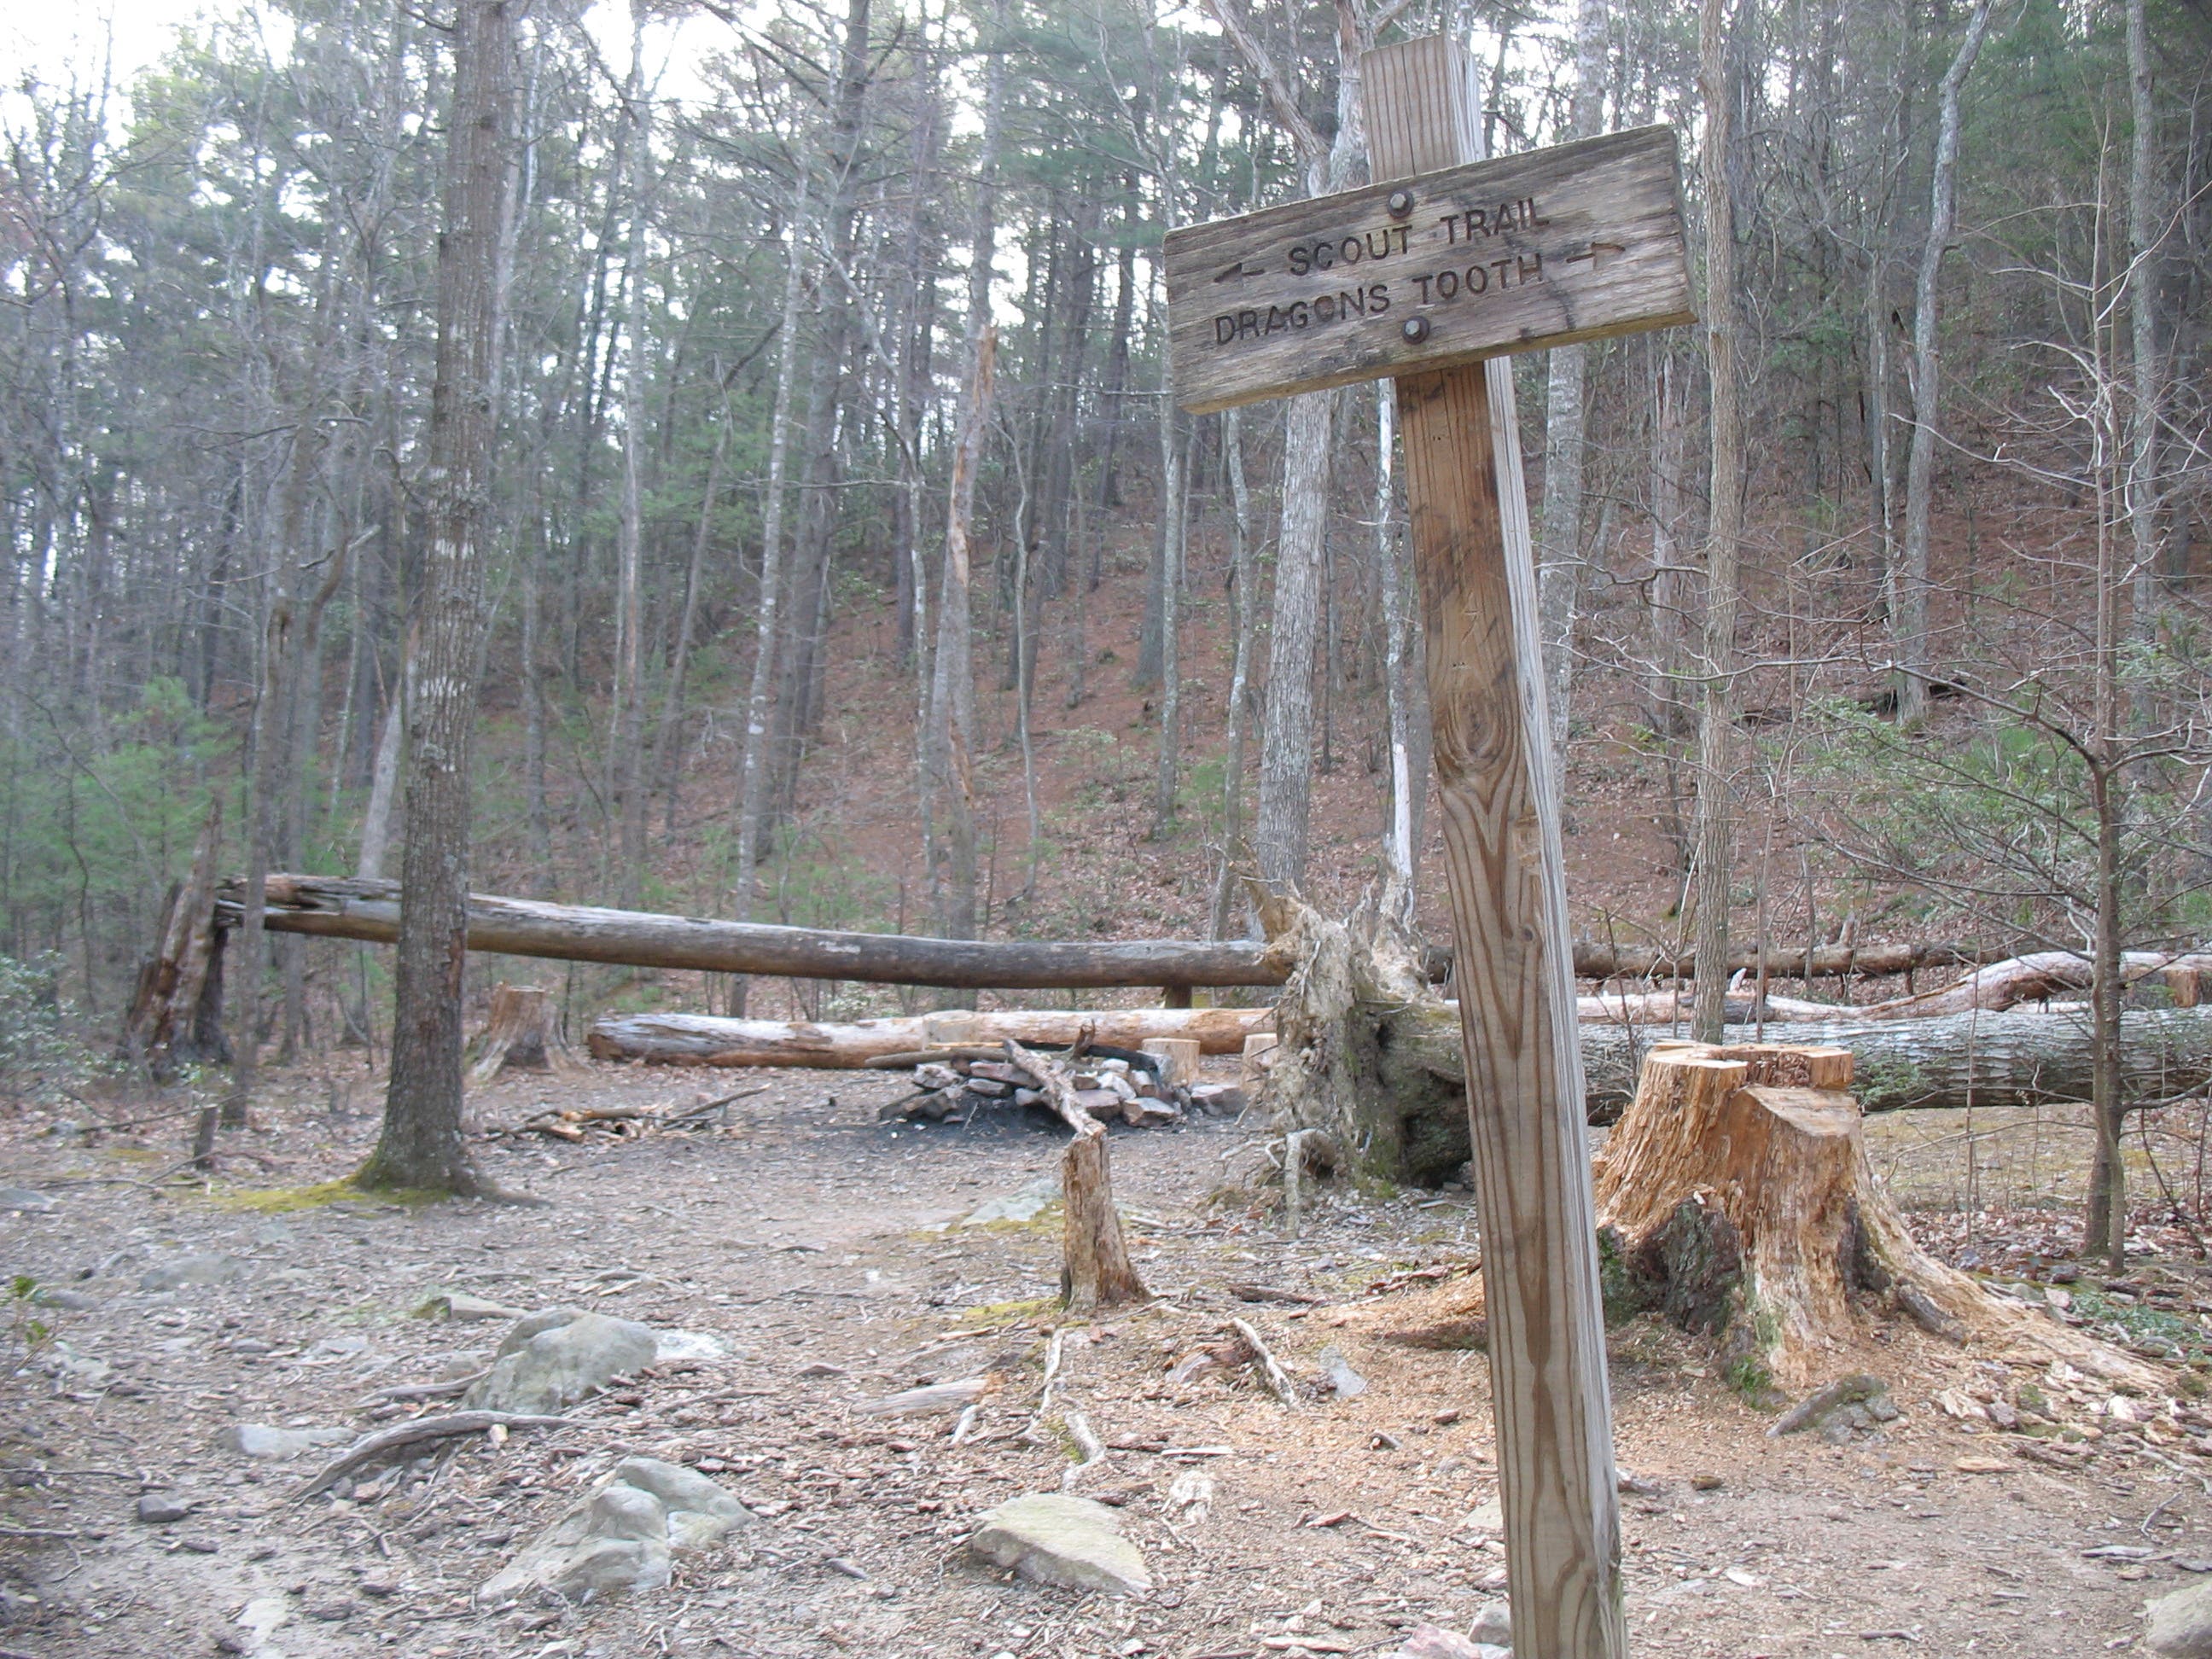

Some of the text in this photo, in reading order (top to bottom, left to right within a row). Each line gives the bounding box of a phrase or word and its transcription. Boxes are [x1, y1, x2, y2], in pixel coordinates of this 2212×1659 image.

[1288, 196, 1550, 277] SCOUT TRAIL
[1215, 253, 1543, 345] DRAGONS TOOTH
